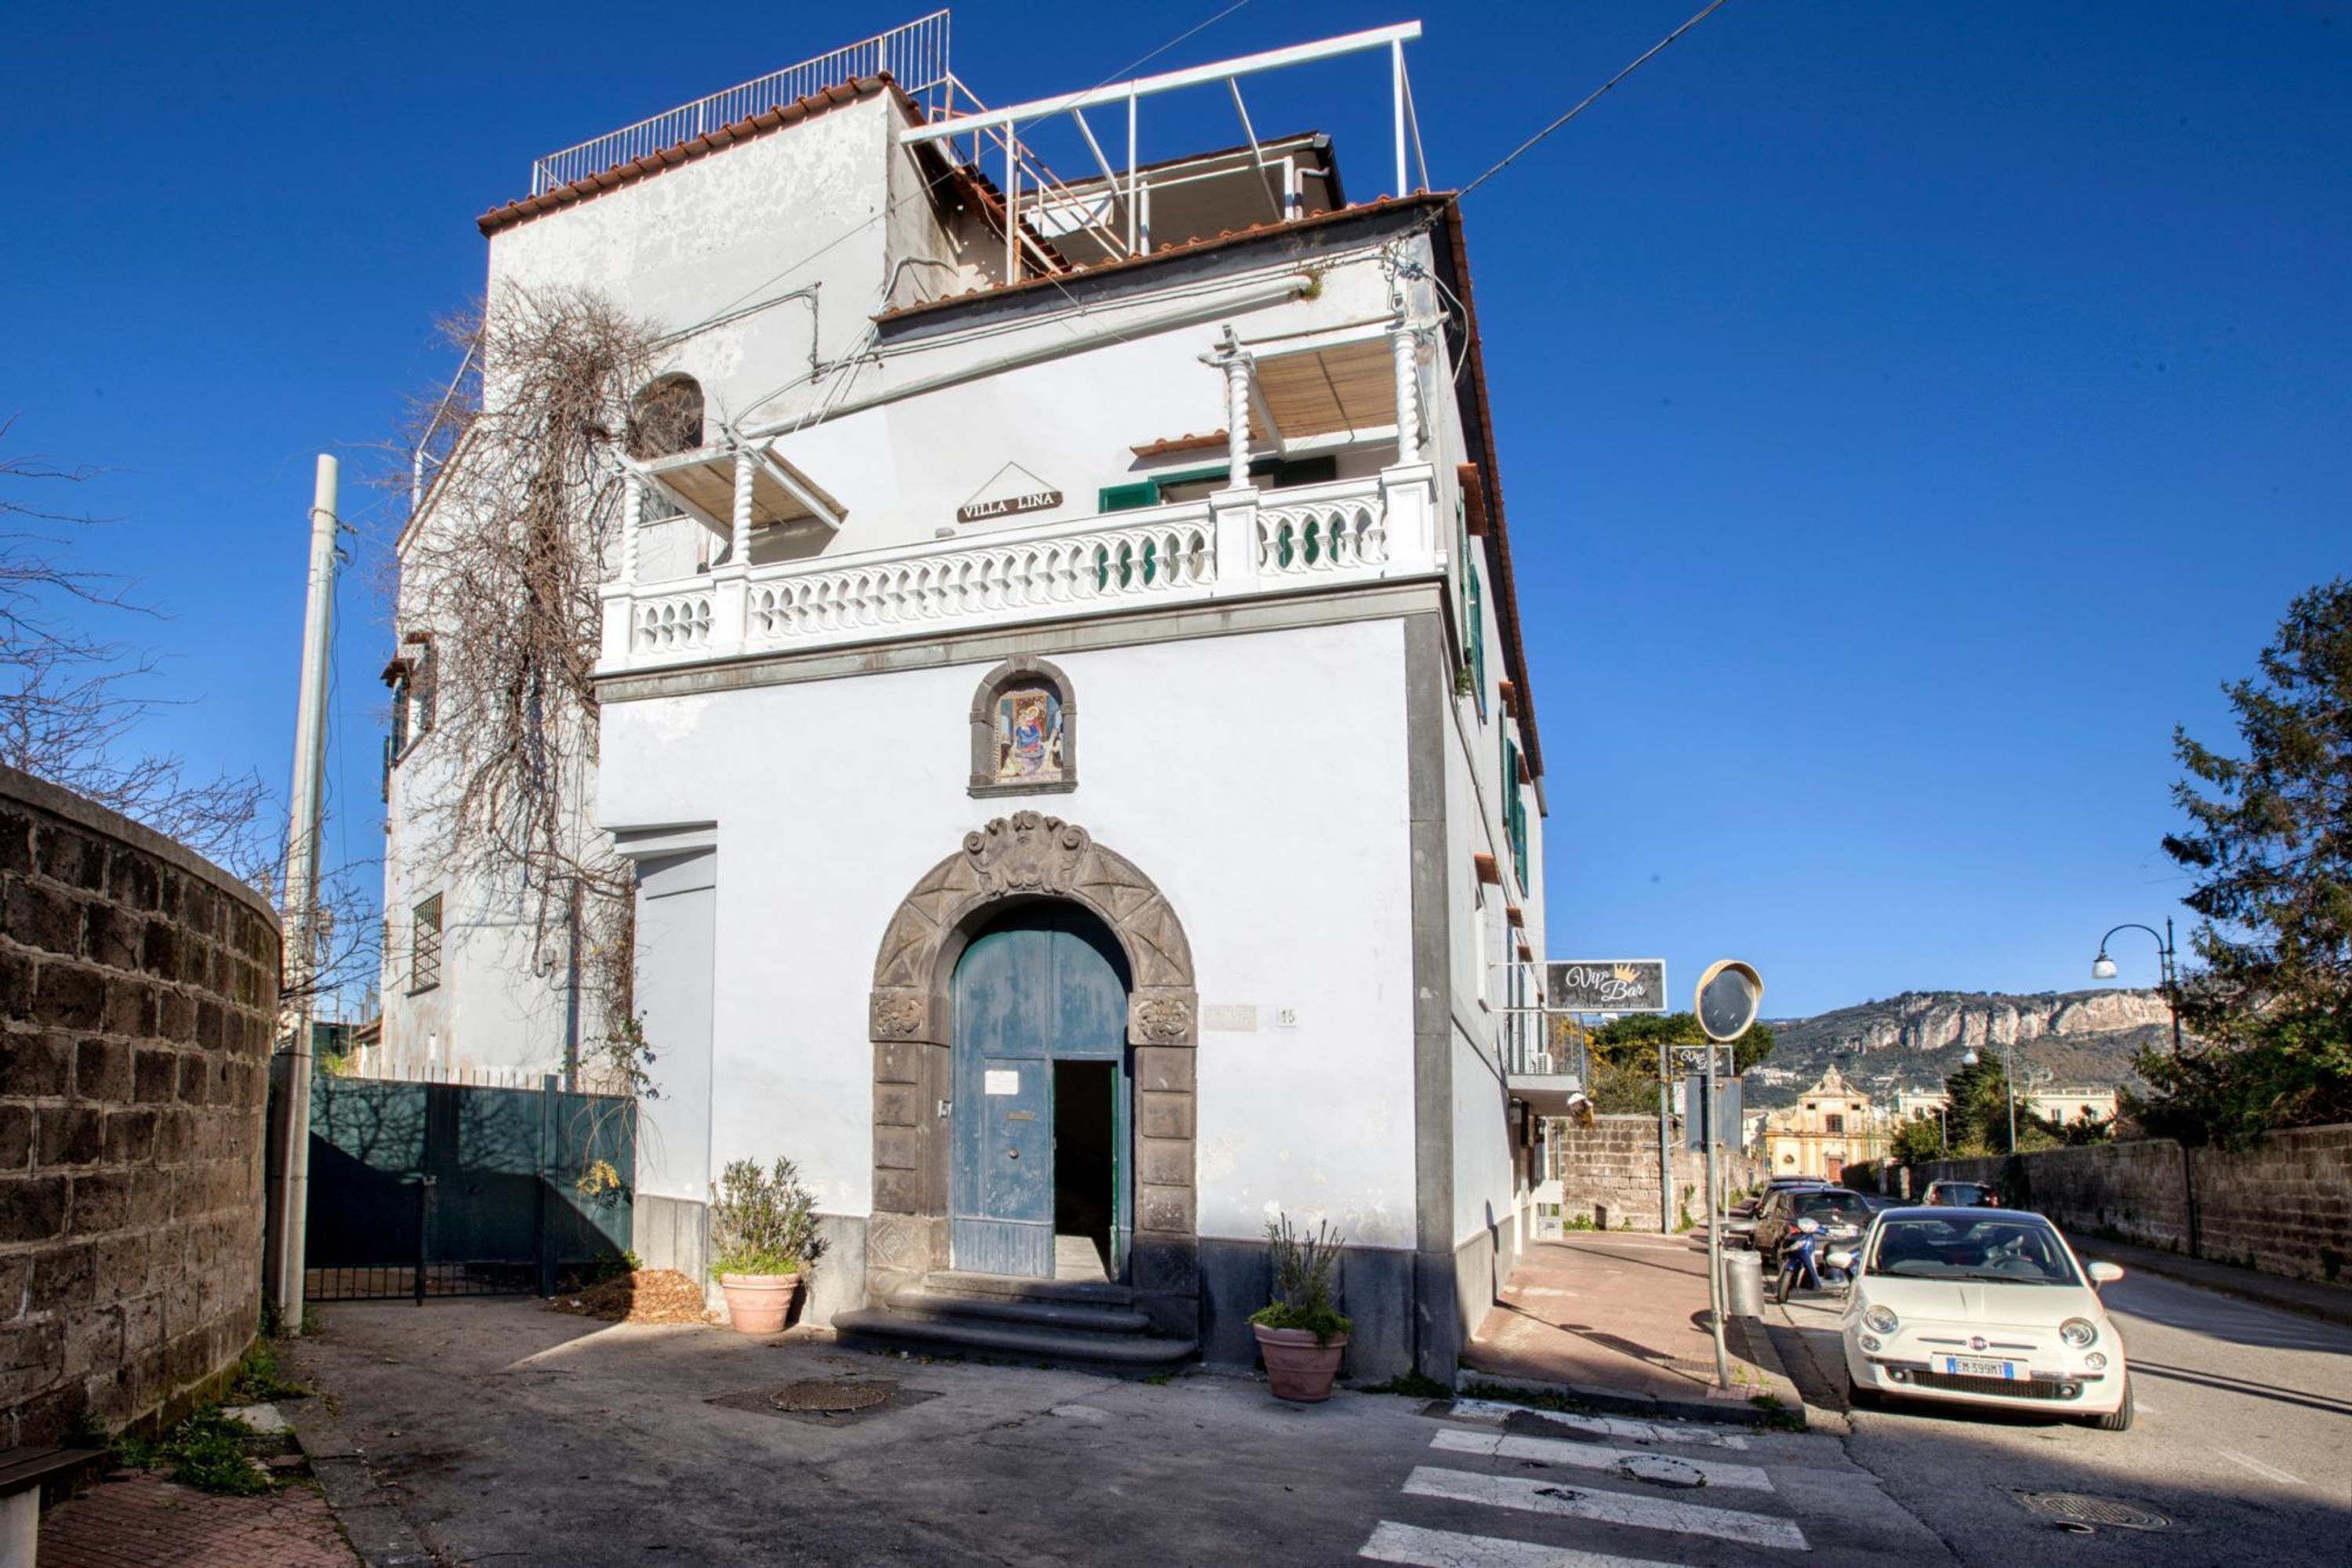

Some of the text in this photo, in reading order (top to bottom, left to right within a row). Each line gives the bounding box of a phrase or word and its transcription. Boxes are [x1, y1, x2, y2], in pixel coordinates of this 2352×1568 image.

[964, 493, 1054, 518] VILLA LINA
[1600, 978, 1646, 1002] Bar
[1281, 1009, 1295, 1024] 15
